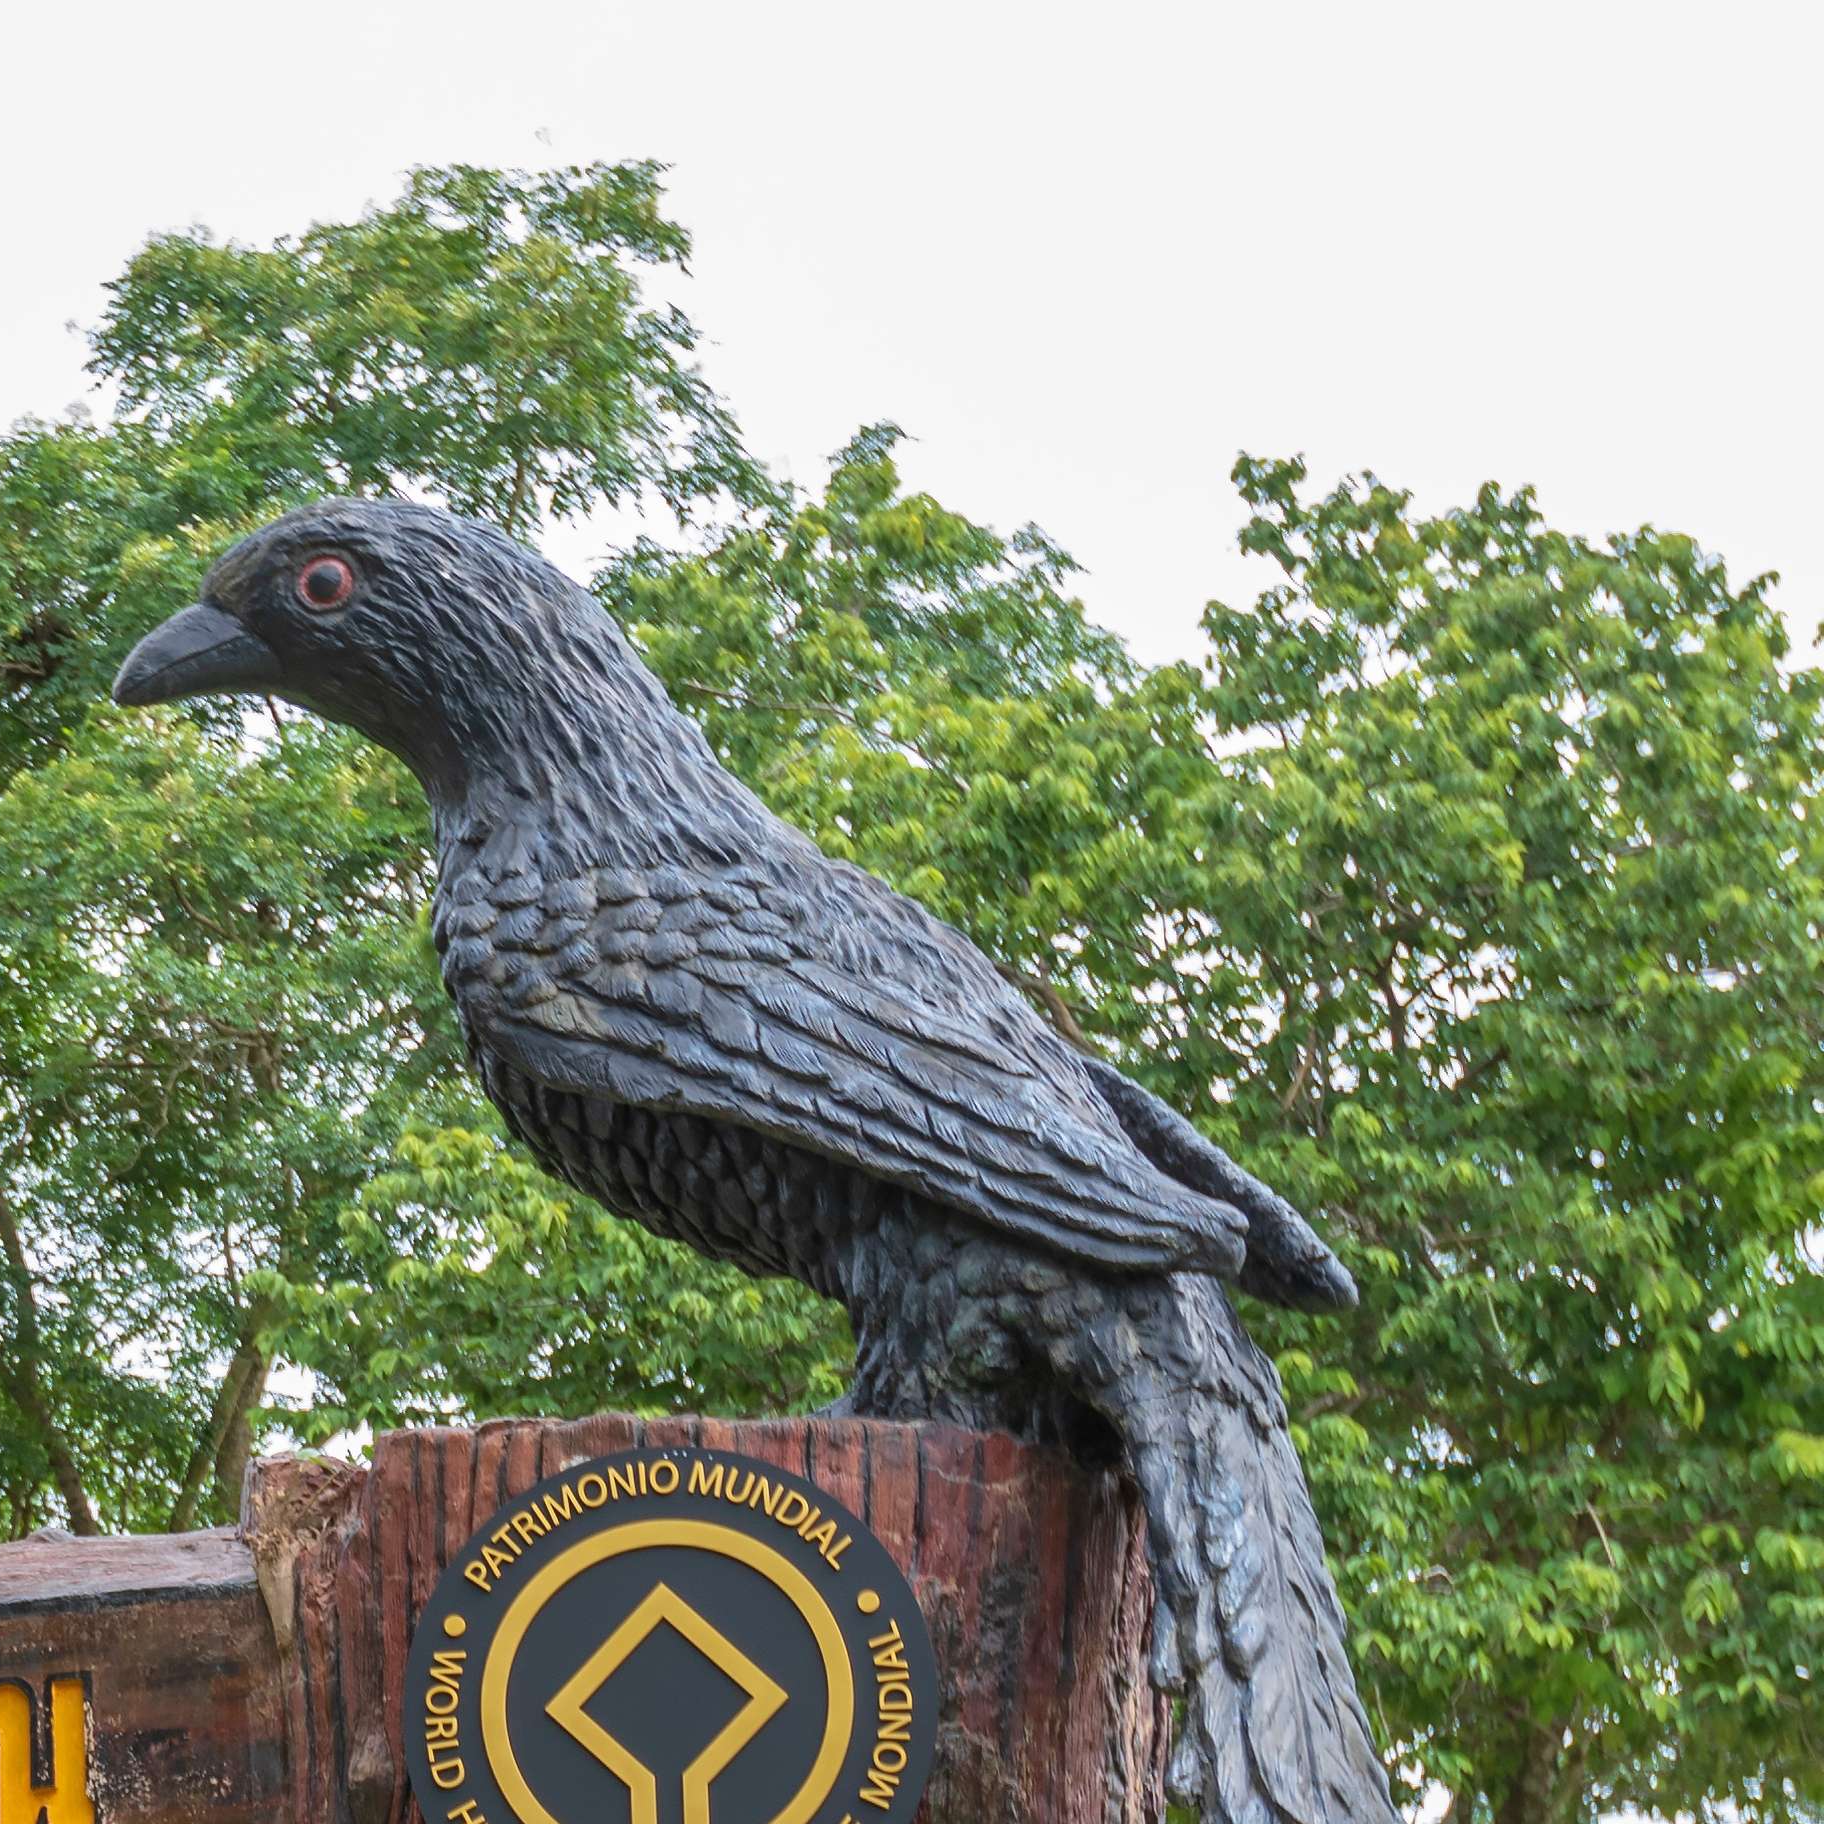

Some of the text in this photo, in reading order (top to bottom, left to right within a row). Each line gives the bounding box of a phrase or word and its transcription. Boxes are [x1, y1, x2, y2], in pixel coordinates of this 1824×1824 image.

[464, 1458, 853, 1592] PATRIMONIO MUNDIAL
[424, 1650, 467, 1789] WORLD
[859, 1618, 913, 1811] MONDIAL
